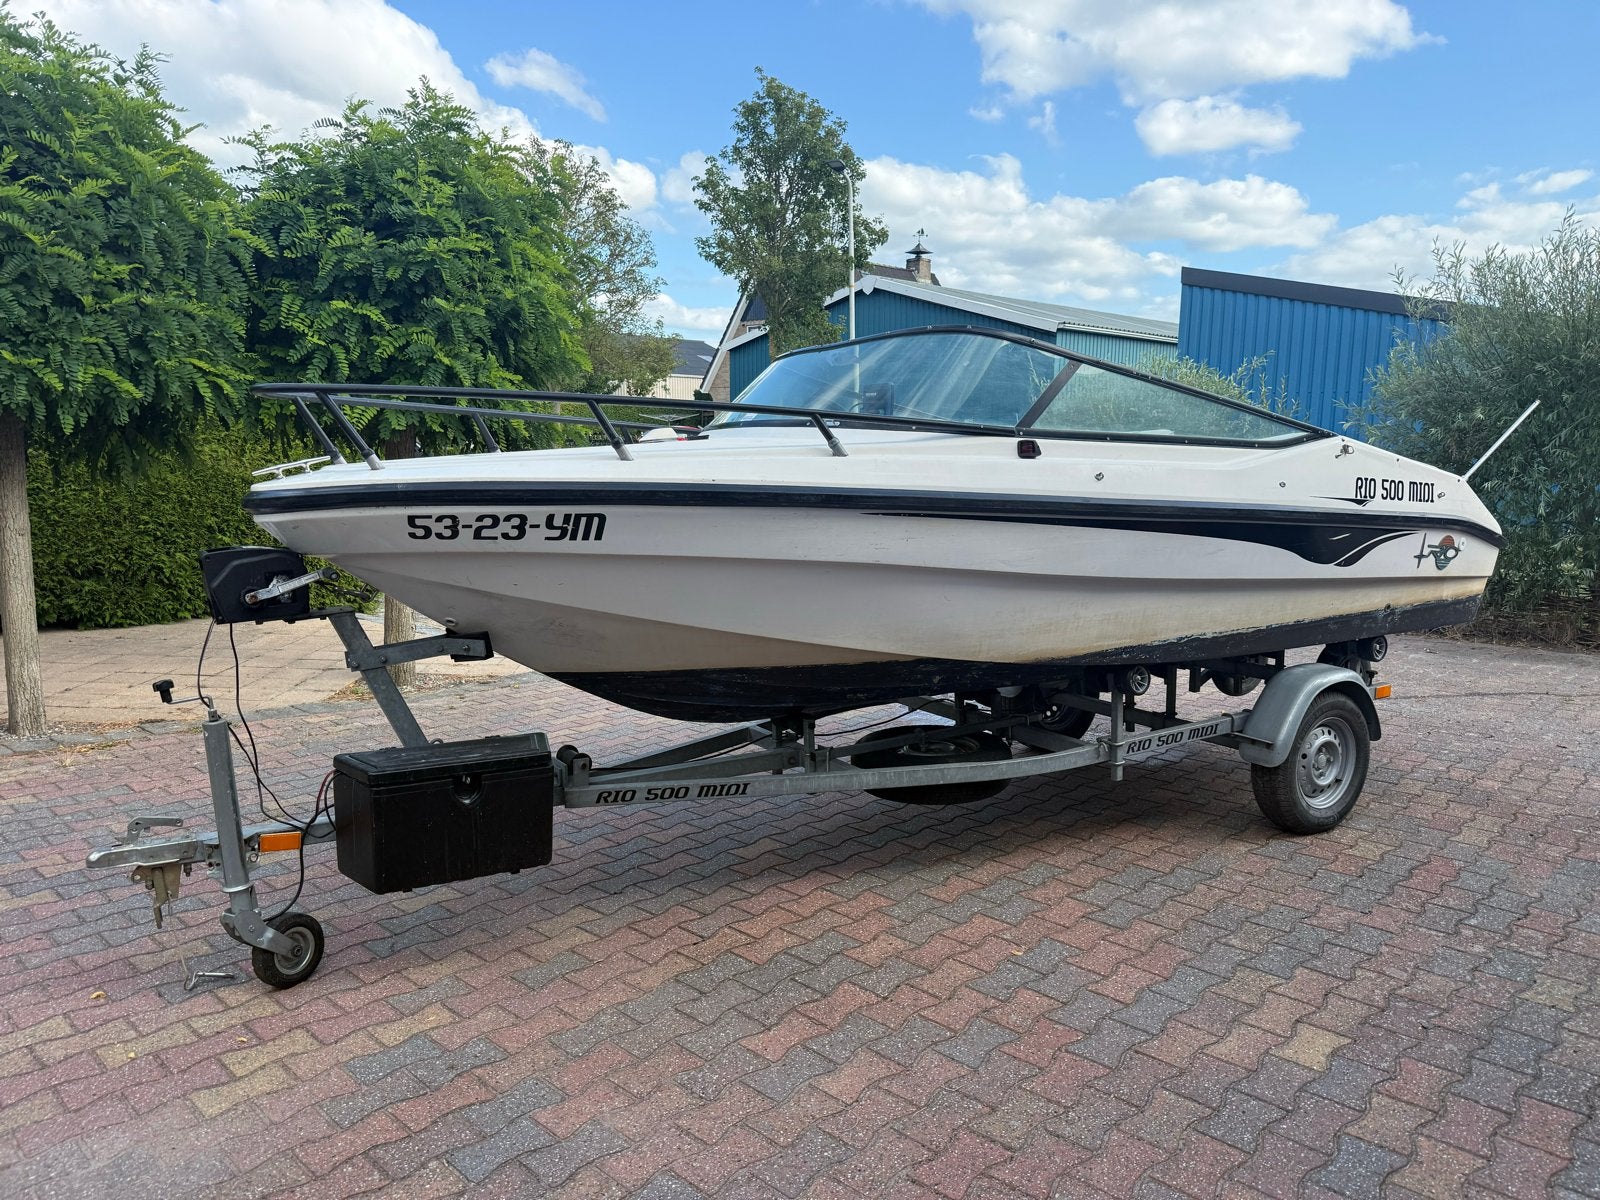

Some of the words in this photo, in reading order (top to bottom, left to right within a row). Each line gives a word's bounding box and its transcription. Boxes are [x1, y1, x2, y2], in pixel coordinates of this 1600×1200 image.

[1355, 477, 1377, 499] RIO
[1381, 479, 1404, 501] 500
[407, 513, 607, 541] 53-23-YM
[1126, 738, 1152, 754] RIO
[1156, 731, 1184, 747] 500
[595, 789, 637, 804] RIO
[644, 786, 690, 801] 500
